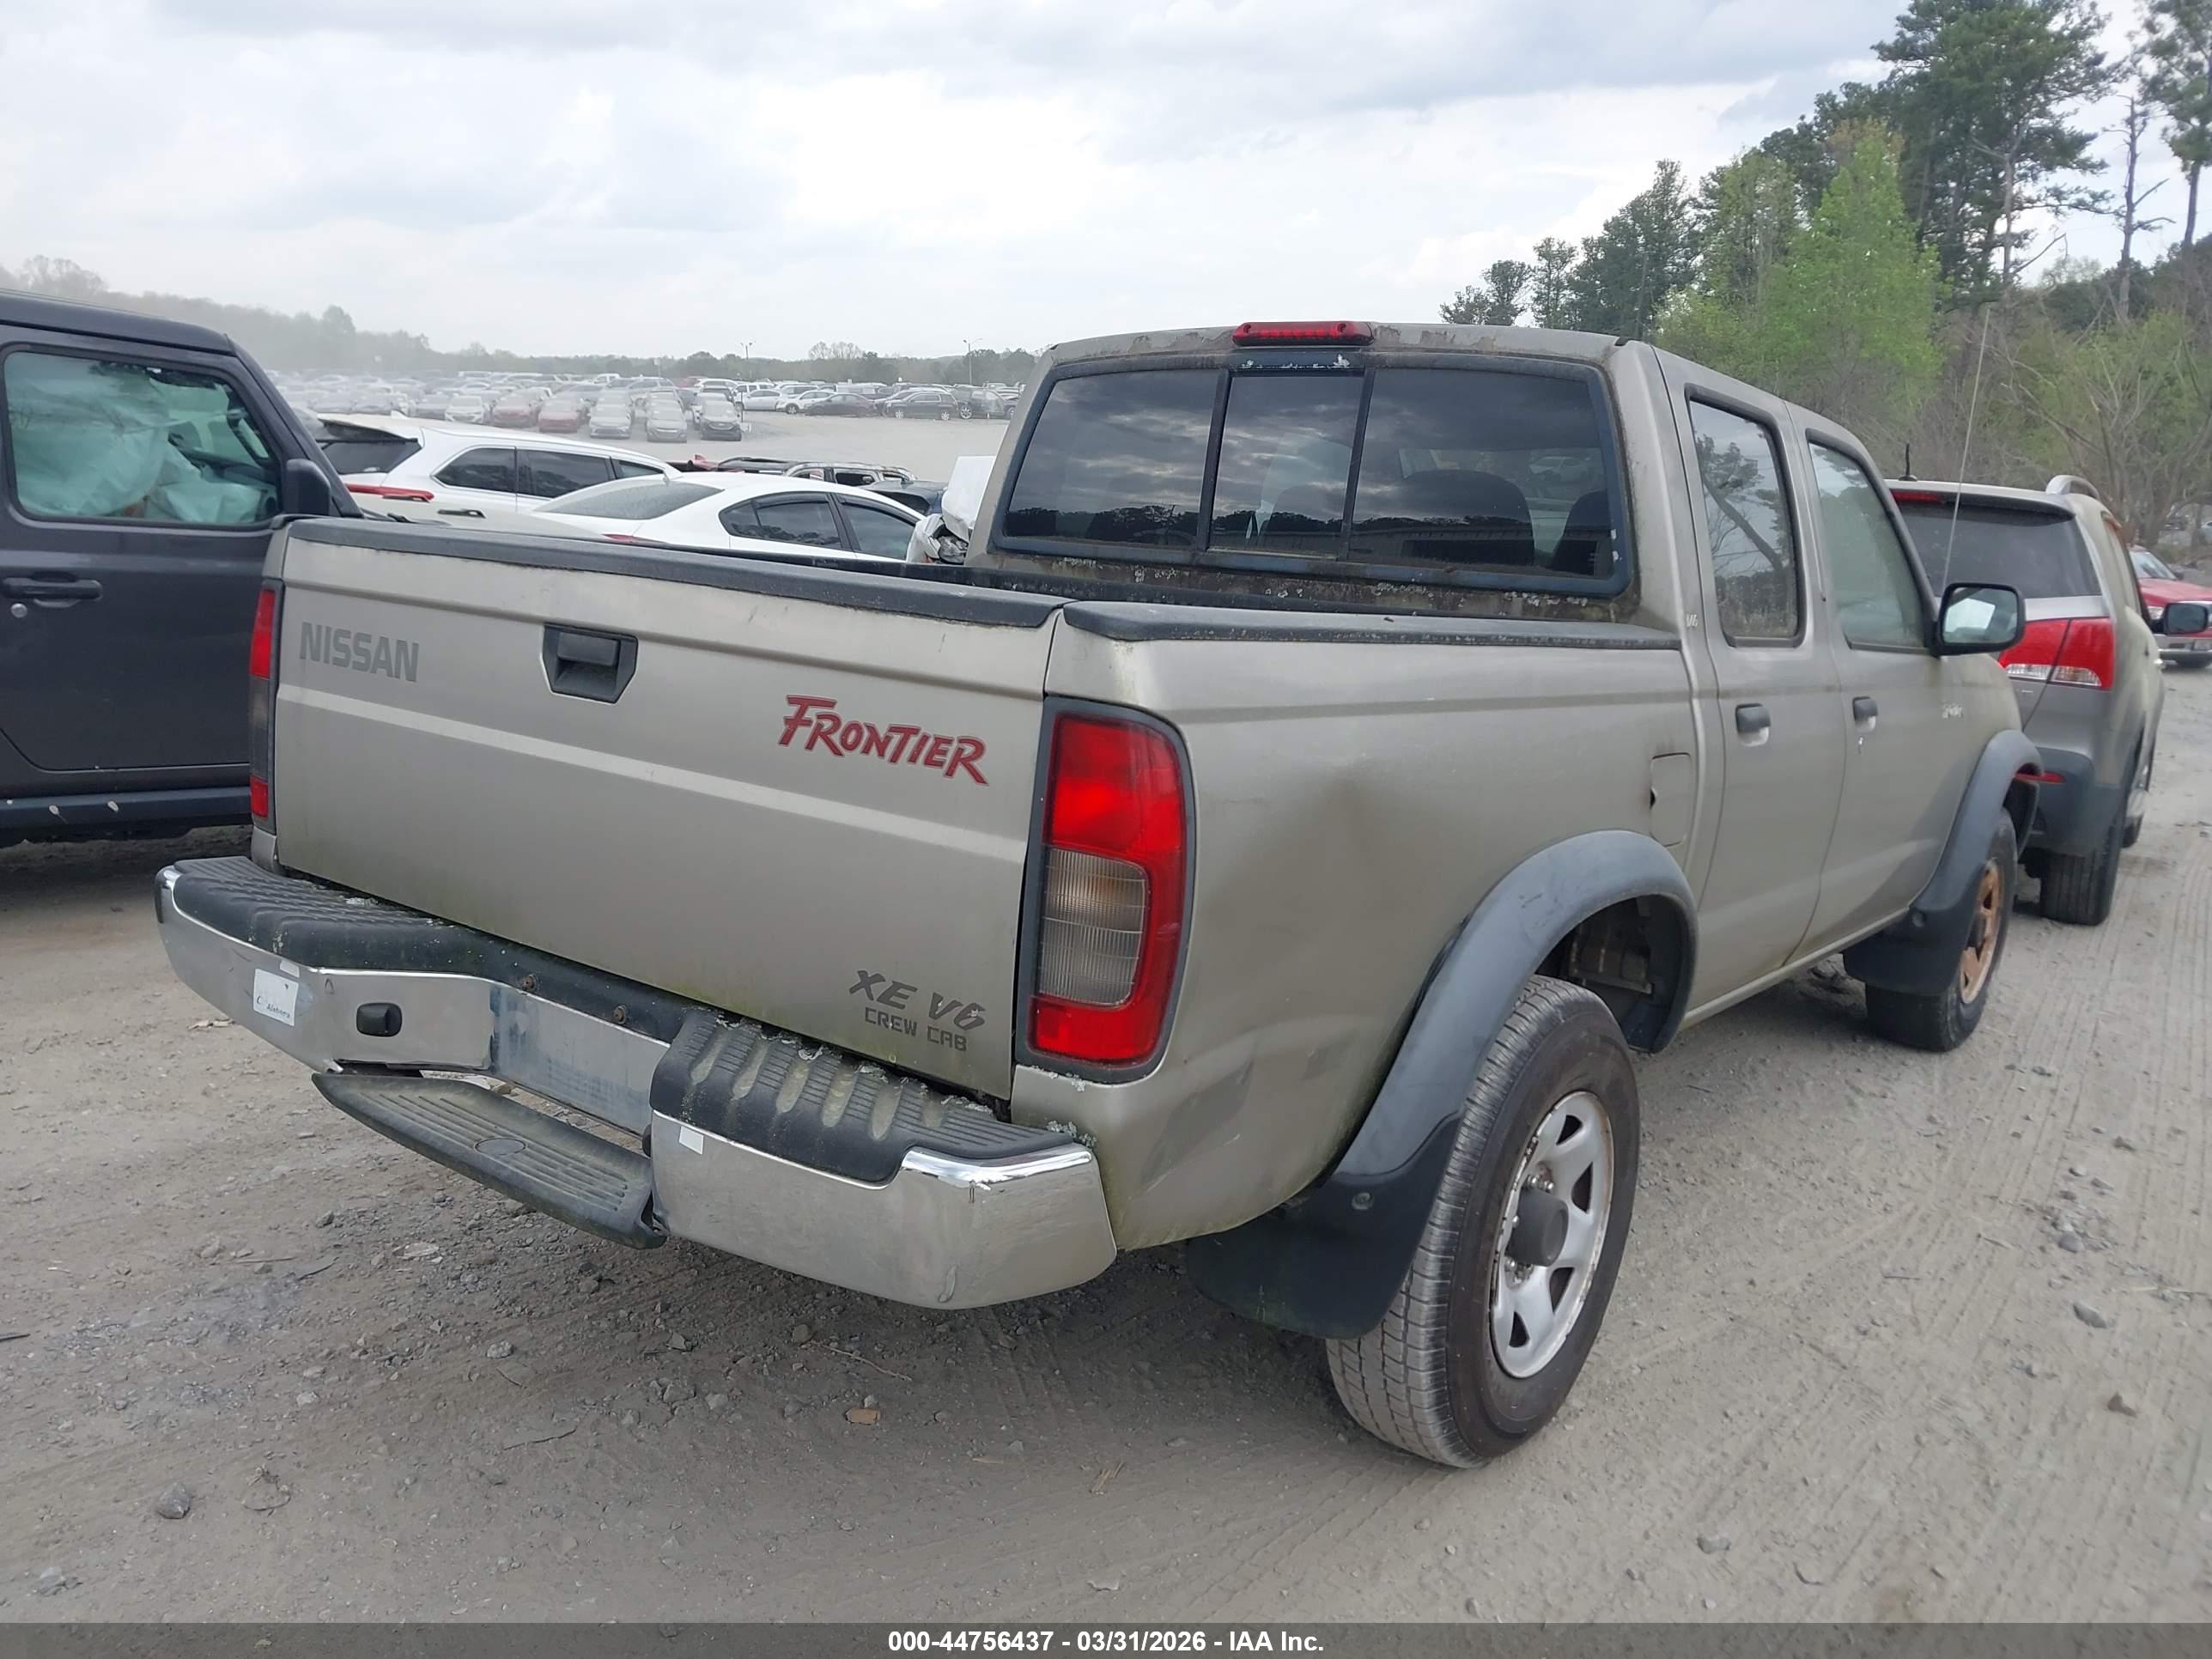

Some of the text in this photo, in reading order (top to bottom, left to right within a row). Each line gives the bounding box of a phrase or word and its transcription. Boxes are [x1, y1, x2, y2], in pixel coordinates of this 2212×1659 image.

[299, 621, 419, 683] NISSAN
[778, 694, 989, 787] FRONTIER
[849, 969, 986, 1030] XE V6
[865, 1006, 967, 1052] CREW CAB
